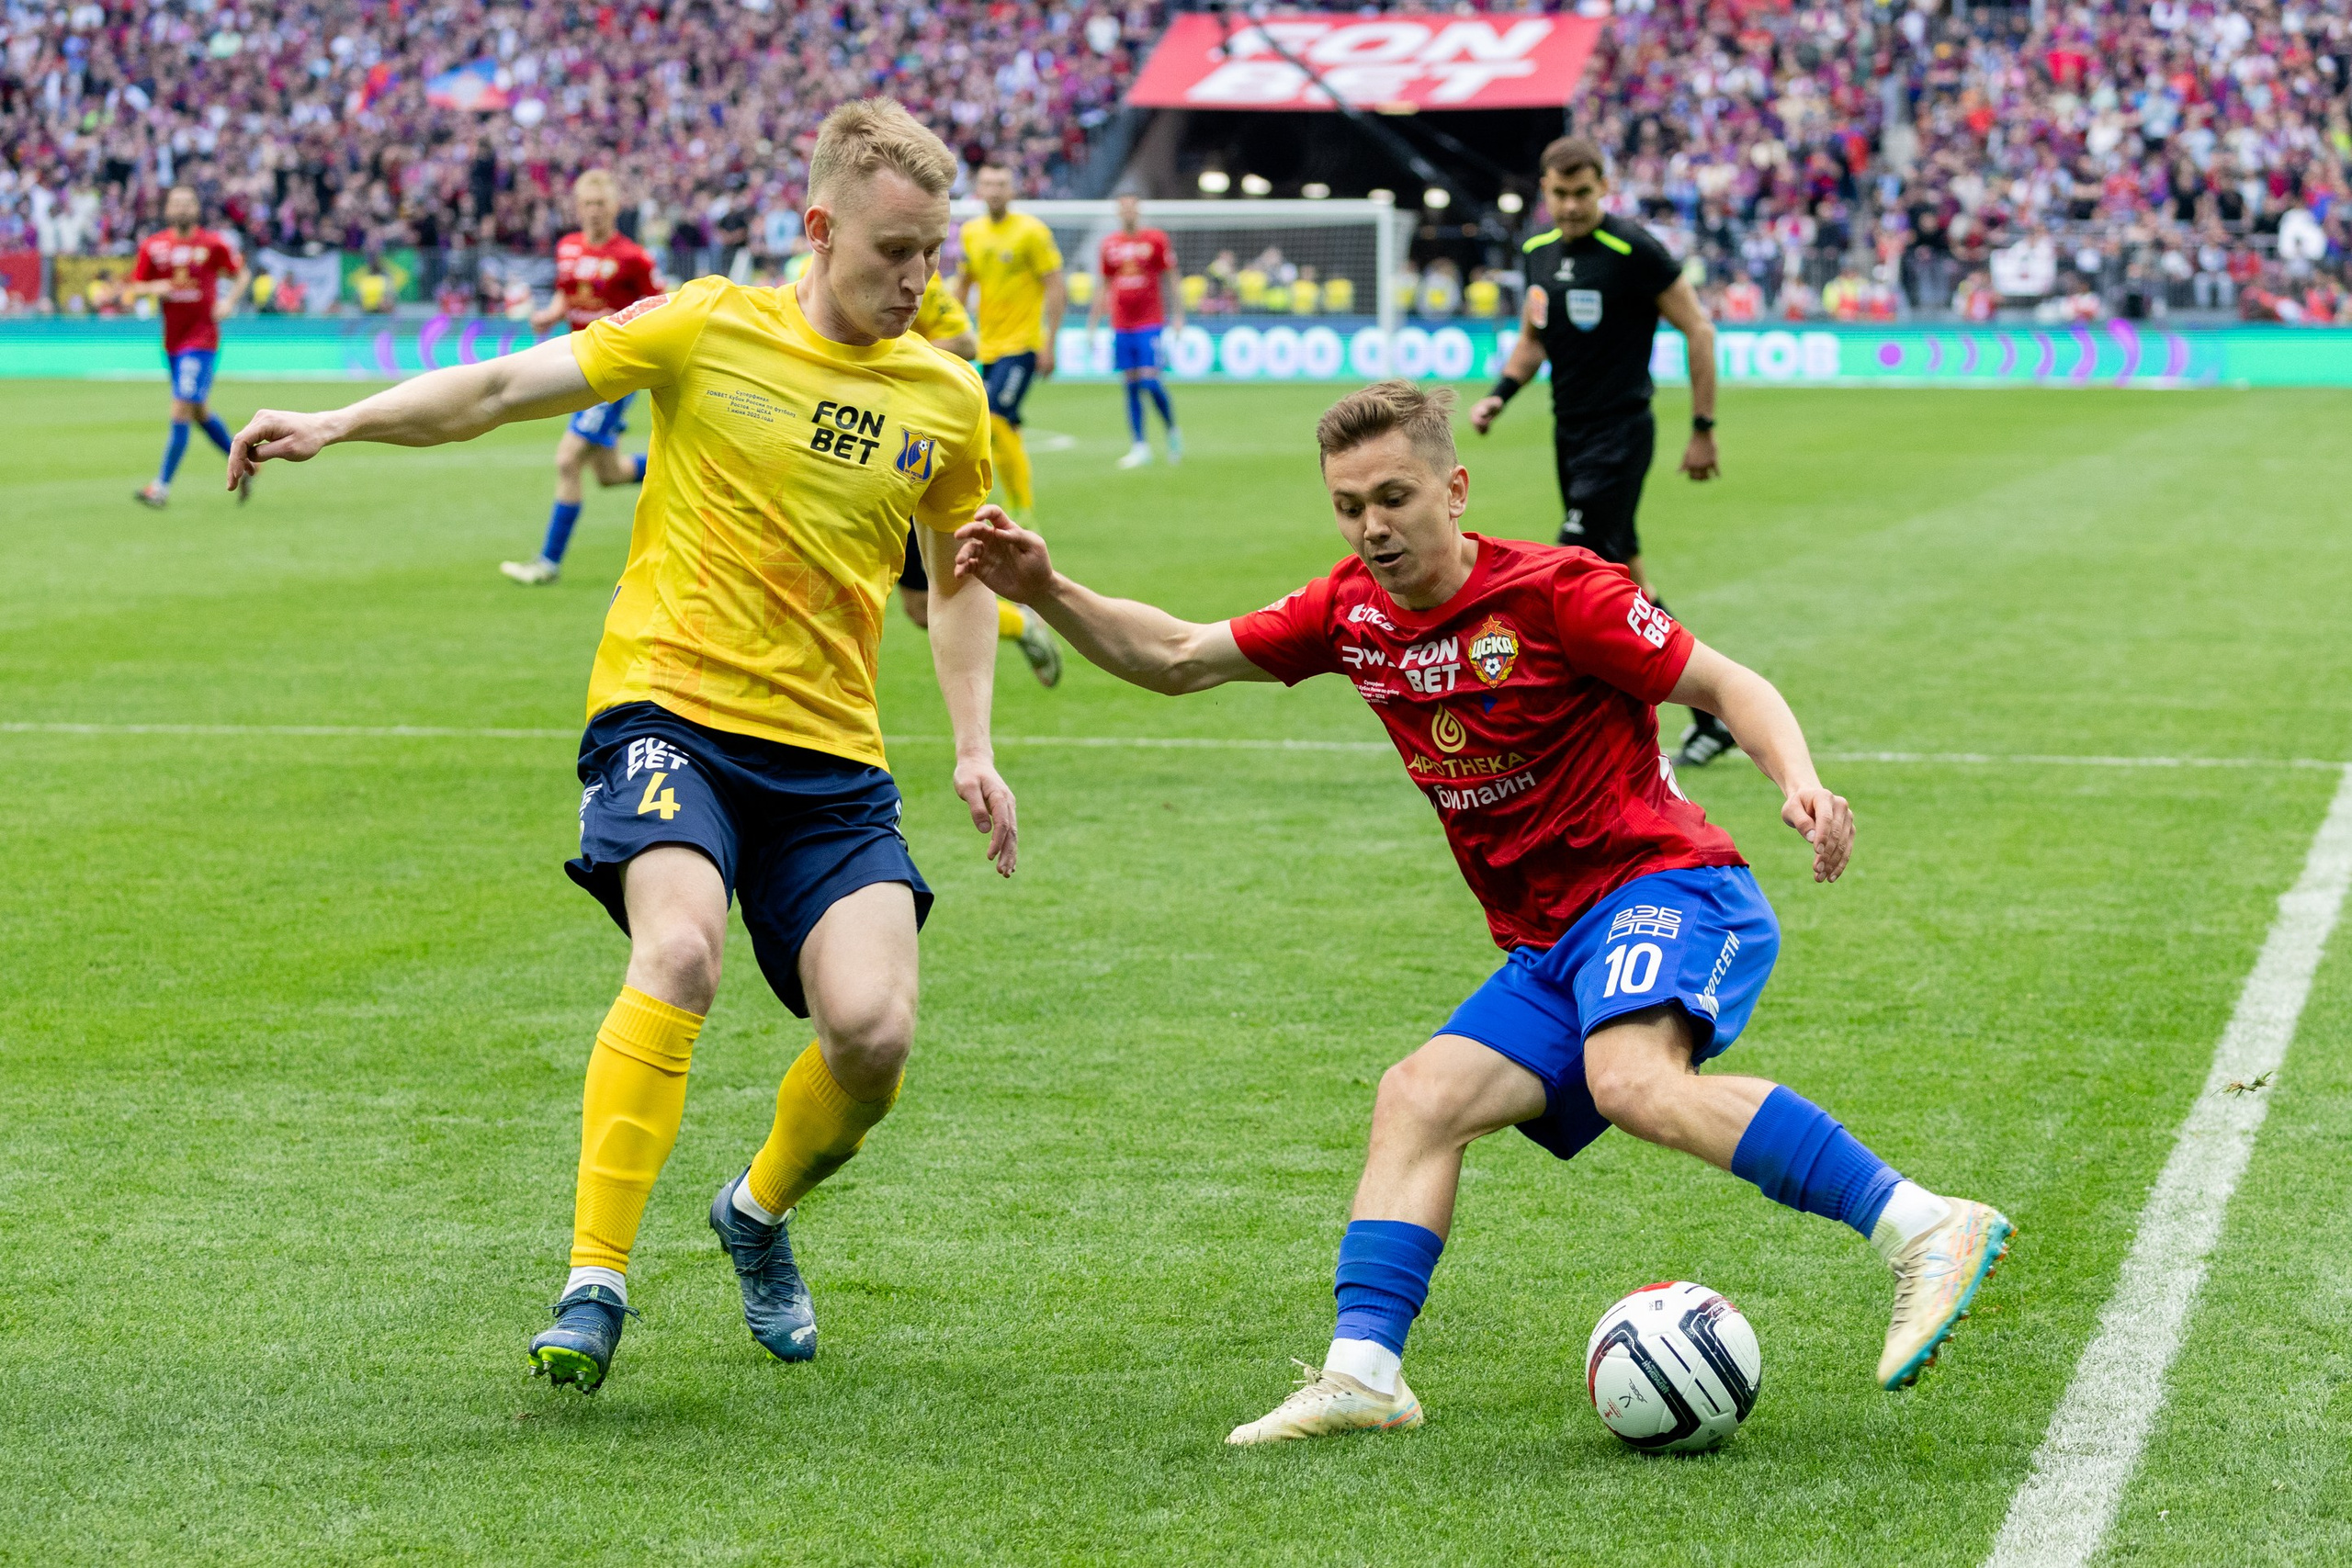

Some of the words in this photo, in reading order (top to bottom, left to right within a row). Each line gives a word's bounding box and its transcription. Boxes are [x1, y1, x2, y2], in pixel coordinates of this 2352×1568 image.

[1207, 17, 1555, 63] FON
[1185, 59, 1538, 104] BET
[1221, 326, 1342, 378] 000
[1350, 326, 1474, 378] 000
[706, 389, 728, 399] FONBET
[729, 394, 745, 402] Кубок
[730, 401, 750, 410] Ростов
[735, 389, 769, 402] Суперфинал
[746, 411, 761, 419] 2025
[811, 400, 886, 438] FON
[809, 427, 880, 466] BET
[1342, 646, 1396, 670] RW
[1398, 637, 1459, 670] FON
[1471, 637, 1515, 660] ЦСКА
[1405, 662, 1461, 694] BET
[628, 737, 689, 767] FO
[1408, 752, 1527, 778] APOTHEKA
[638, 772, 681, 819] 4
[1433, 772, 1536, 810] билайн
[1603, 942, 1663, 998] 10
[1702, 930, 1740, 998] РОССЕТИ
